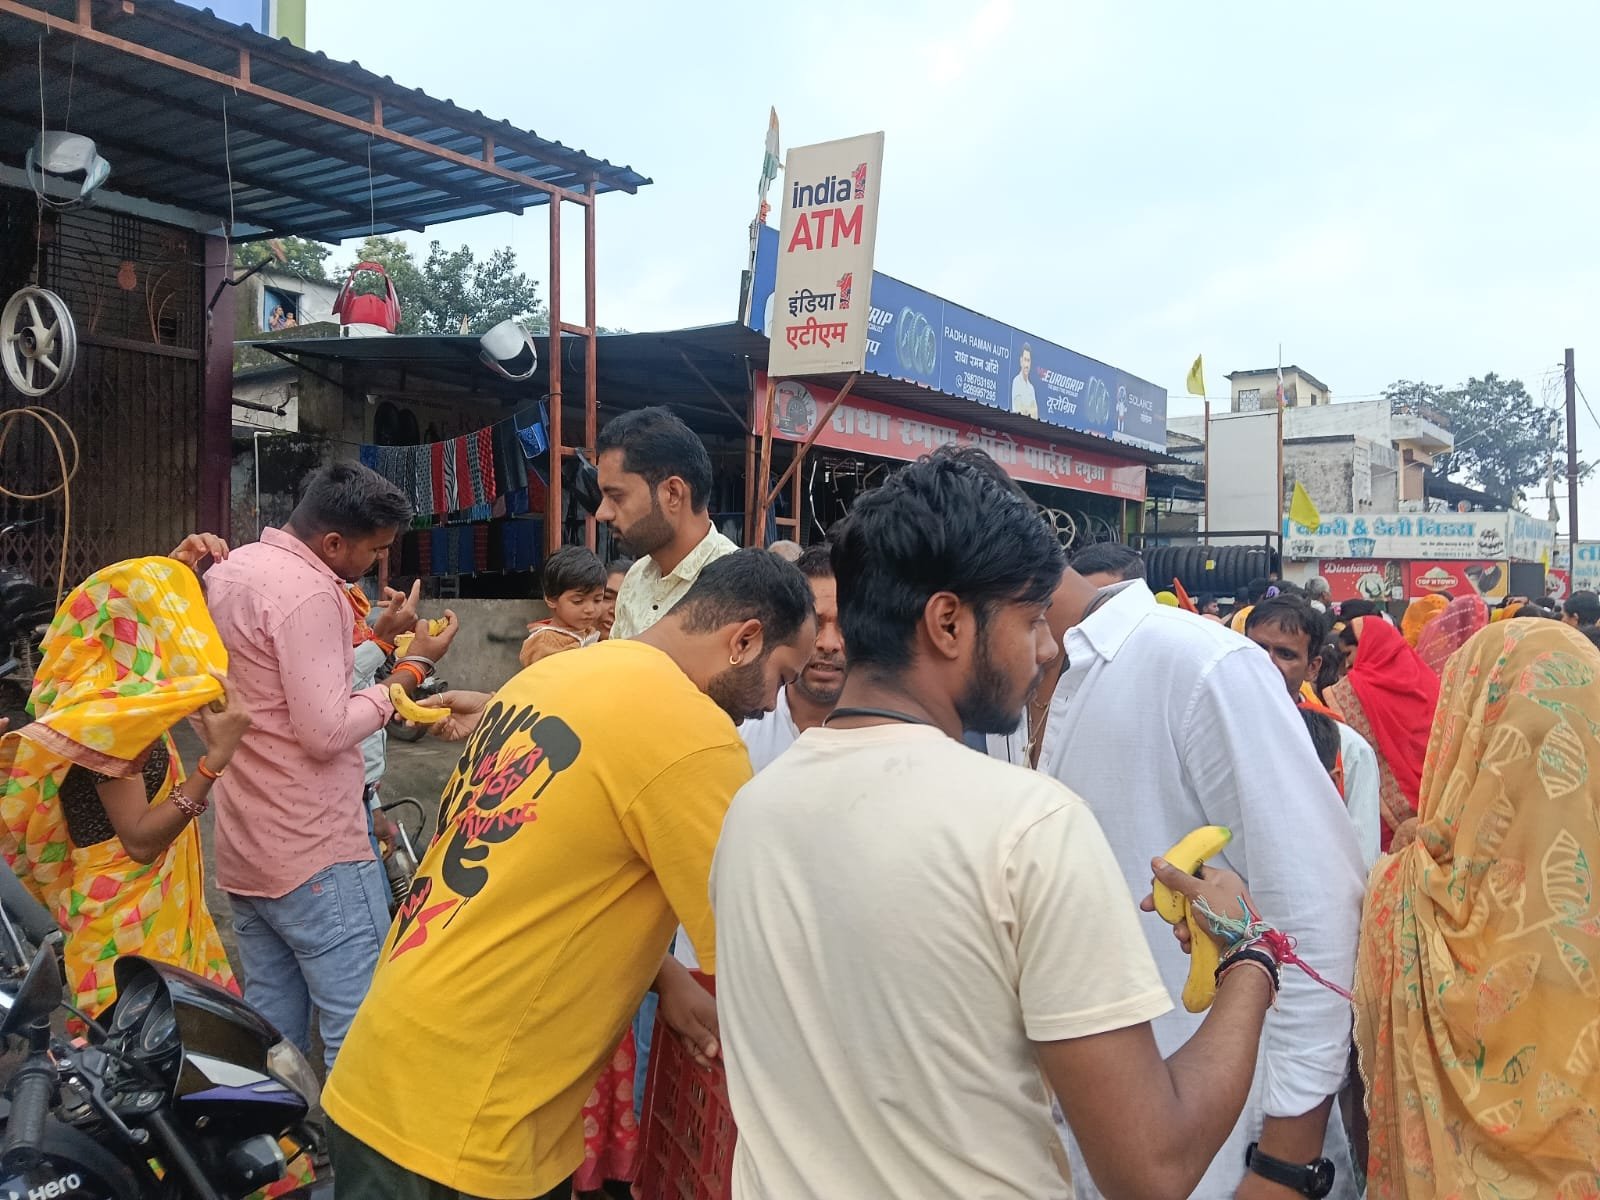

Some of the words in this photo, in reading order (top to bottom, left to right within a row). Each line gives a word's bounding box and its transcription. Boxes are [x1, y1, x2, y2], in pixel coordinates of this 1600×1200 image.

[788, 204, 864, 252] ATM
[786, 317, 848, 350] एटीएम
[944, 326, 968, 345] RADHA
[969, 335, 992, 353] RAMAN
[992, 344, 1010, 359] AUTO
[1042, 370, 1085, 393] EUROGRIP
[1353, 516, 1368, 536] &
[28, 1172, 81, 1200] Hero
